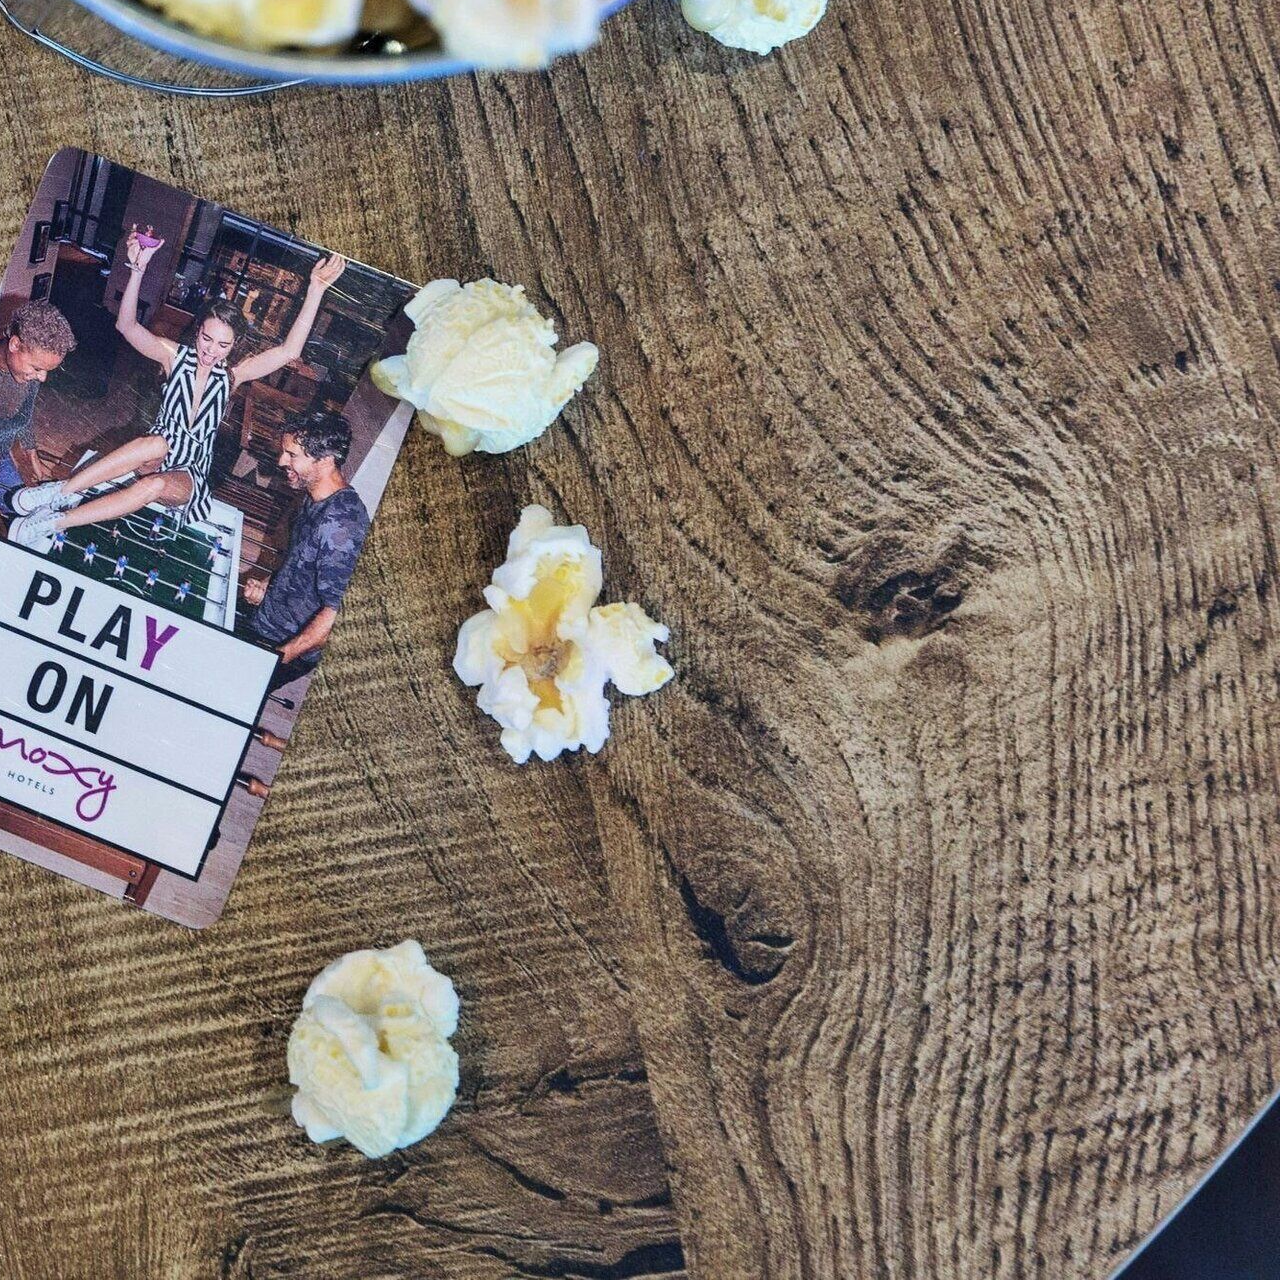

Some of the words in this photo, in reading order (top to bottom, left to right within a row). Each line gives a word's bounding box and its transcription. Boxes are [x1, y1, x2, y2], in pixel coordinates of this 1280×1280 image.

[17, 569, 180, 671] PLAY
[26, 660, 115, 735] ON
[6, 769, 56, 796] HOTELS
